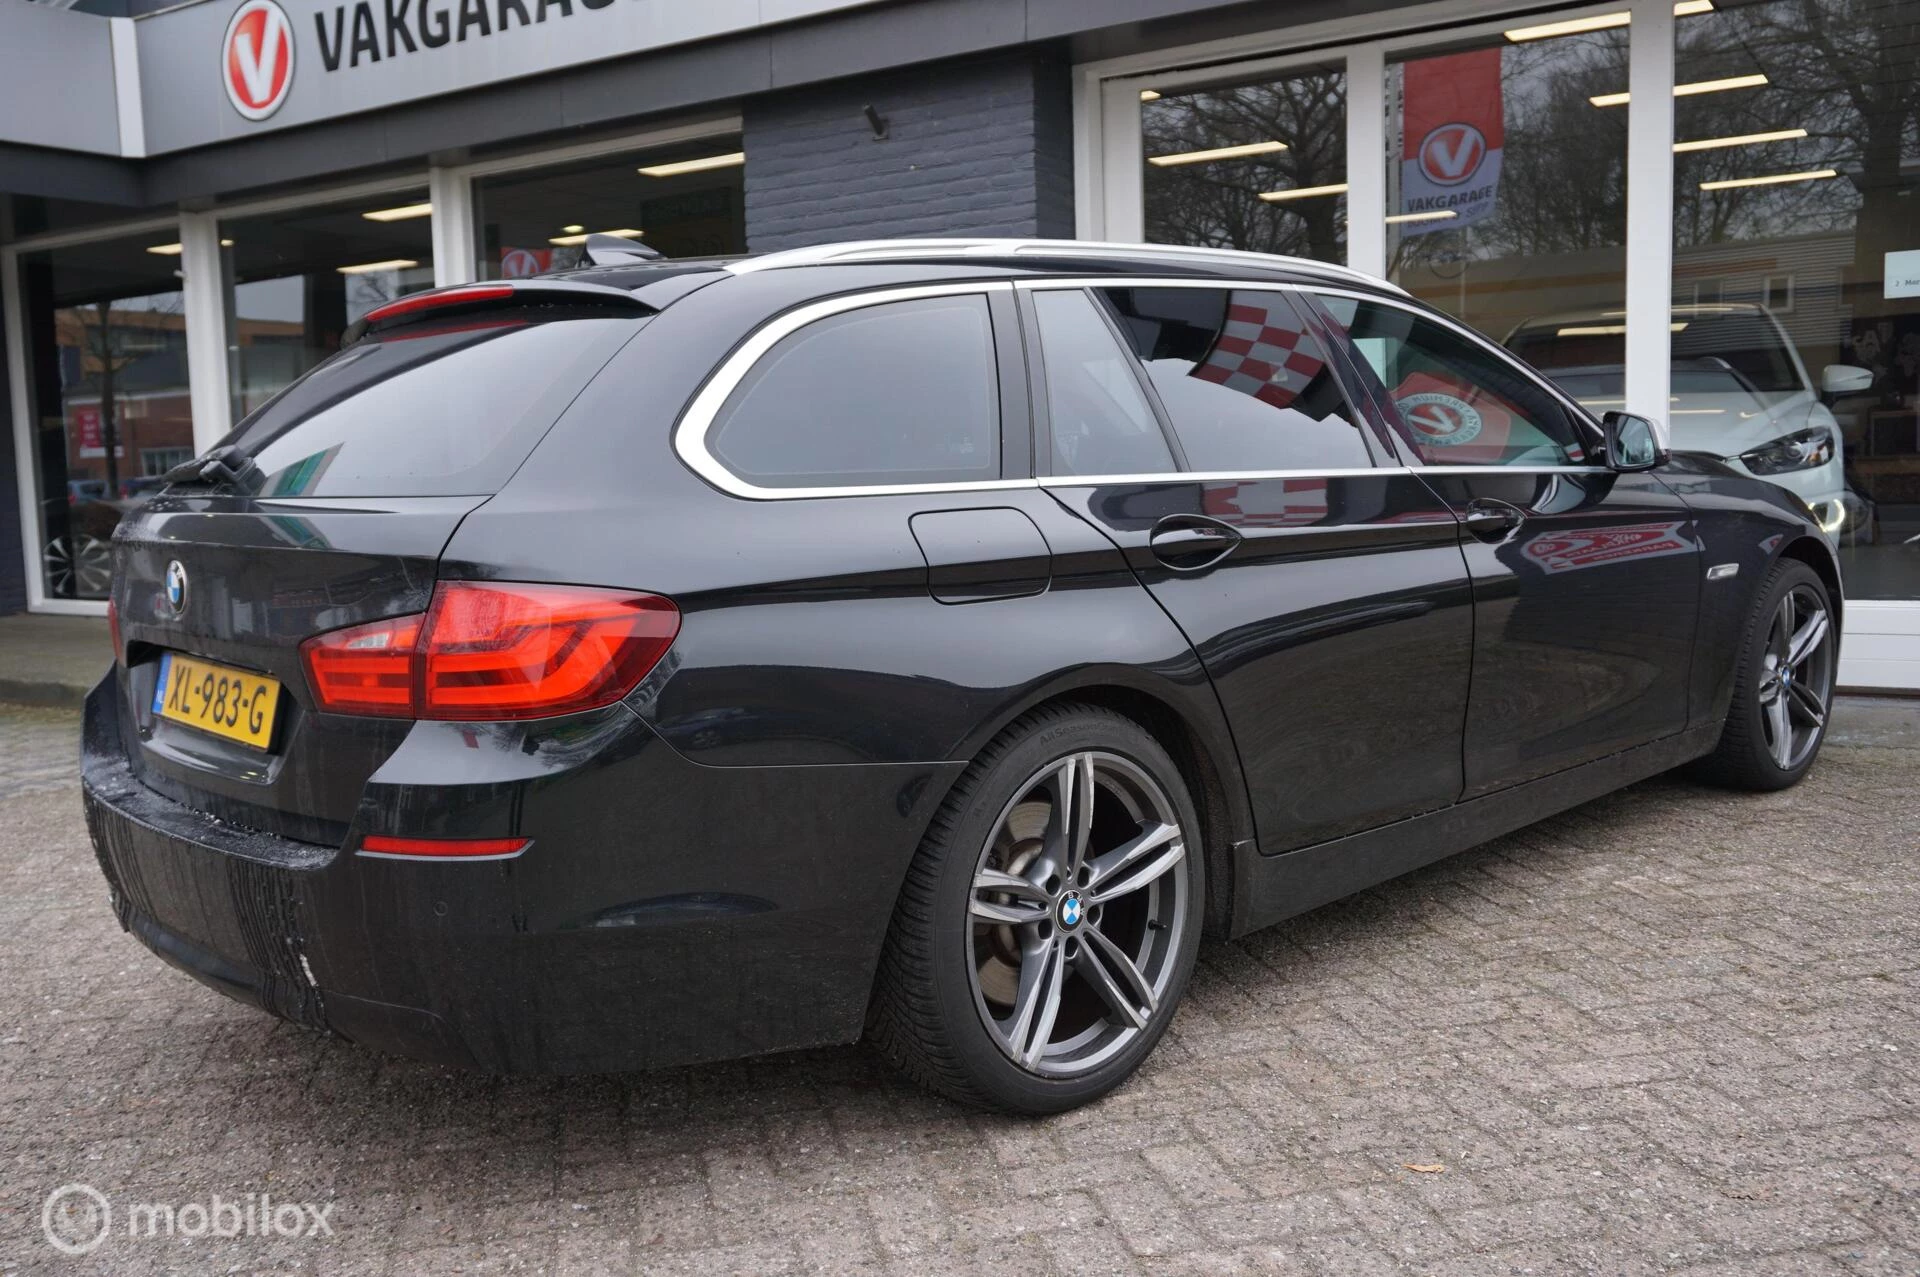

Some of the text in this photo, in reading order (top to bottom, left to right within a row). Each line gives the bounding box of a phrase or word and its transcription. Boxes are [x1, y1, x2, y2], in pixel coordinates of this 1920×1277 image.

[314, 0, 614, 72] VAKGAR
[1407, 185, 1493, 212] VAKGARAGE
[168, 664, 267, 735] XL-983-G
